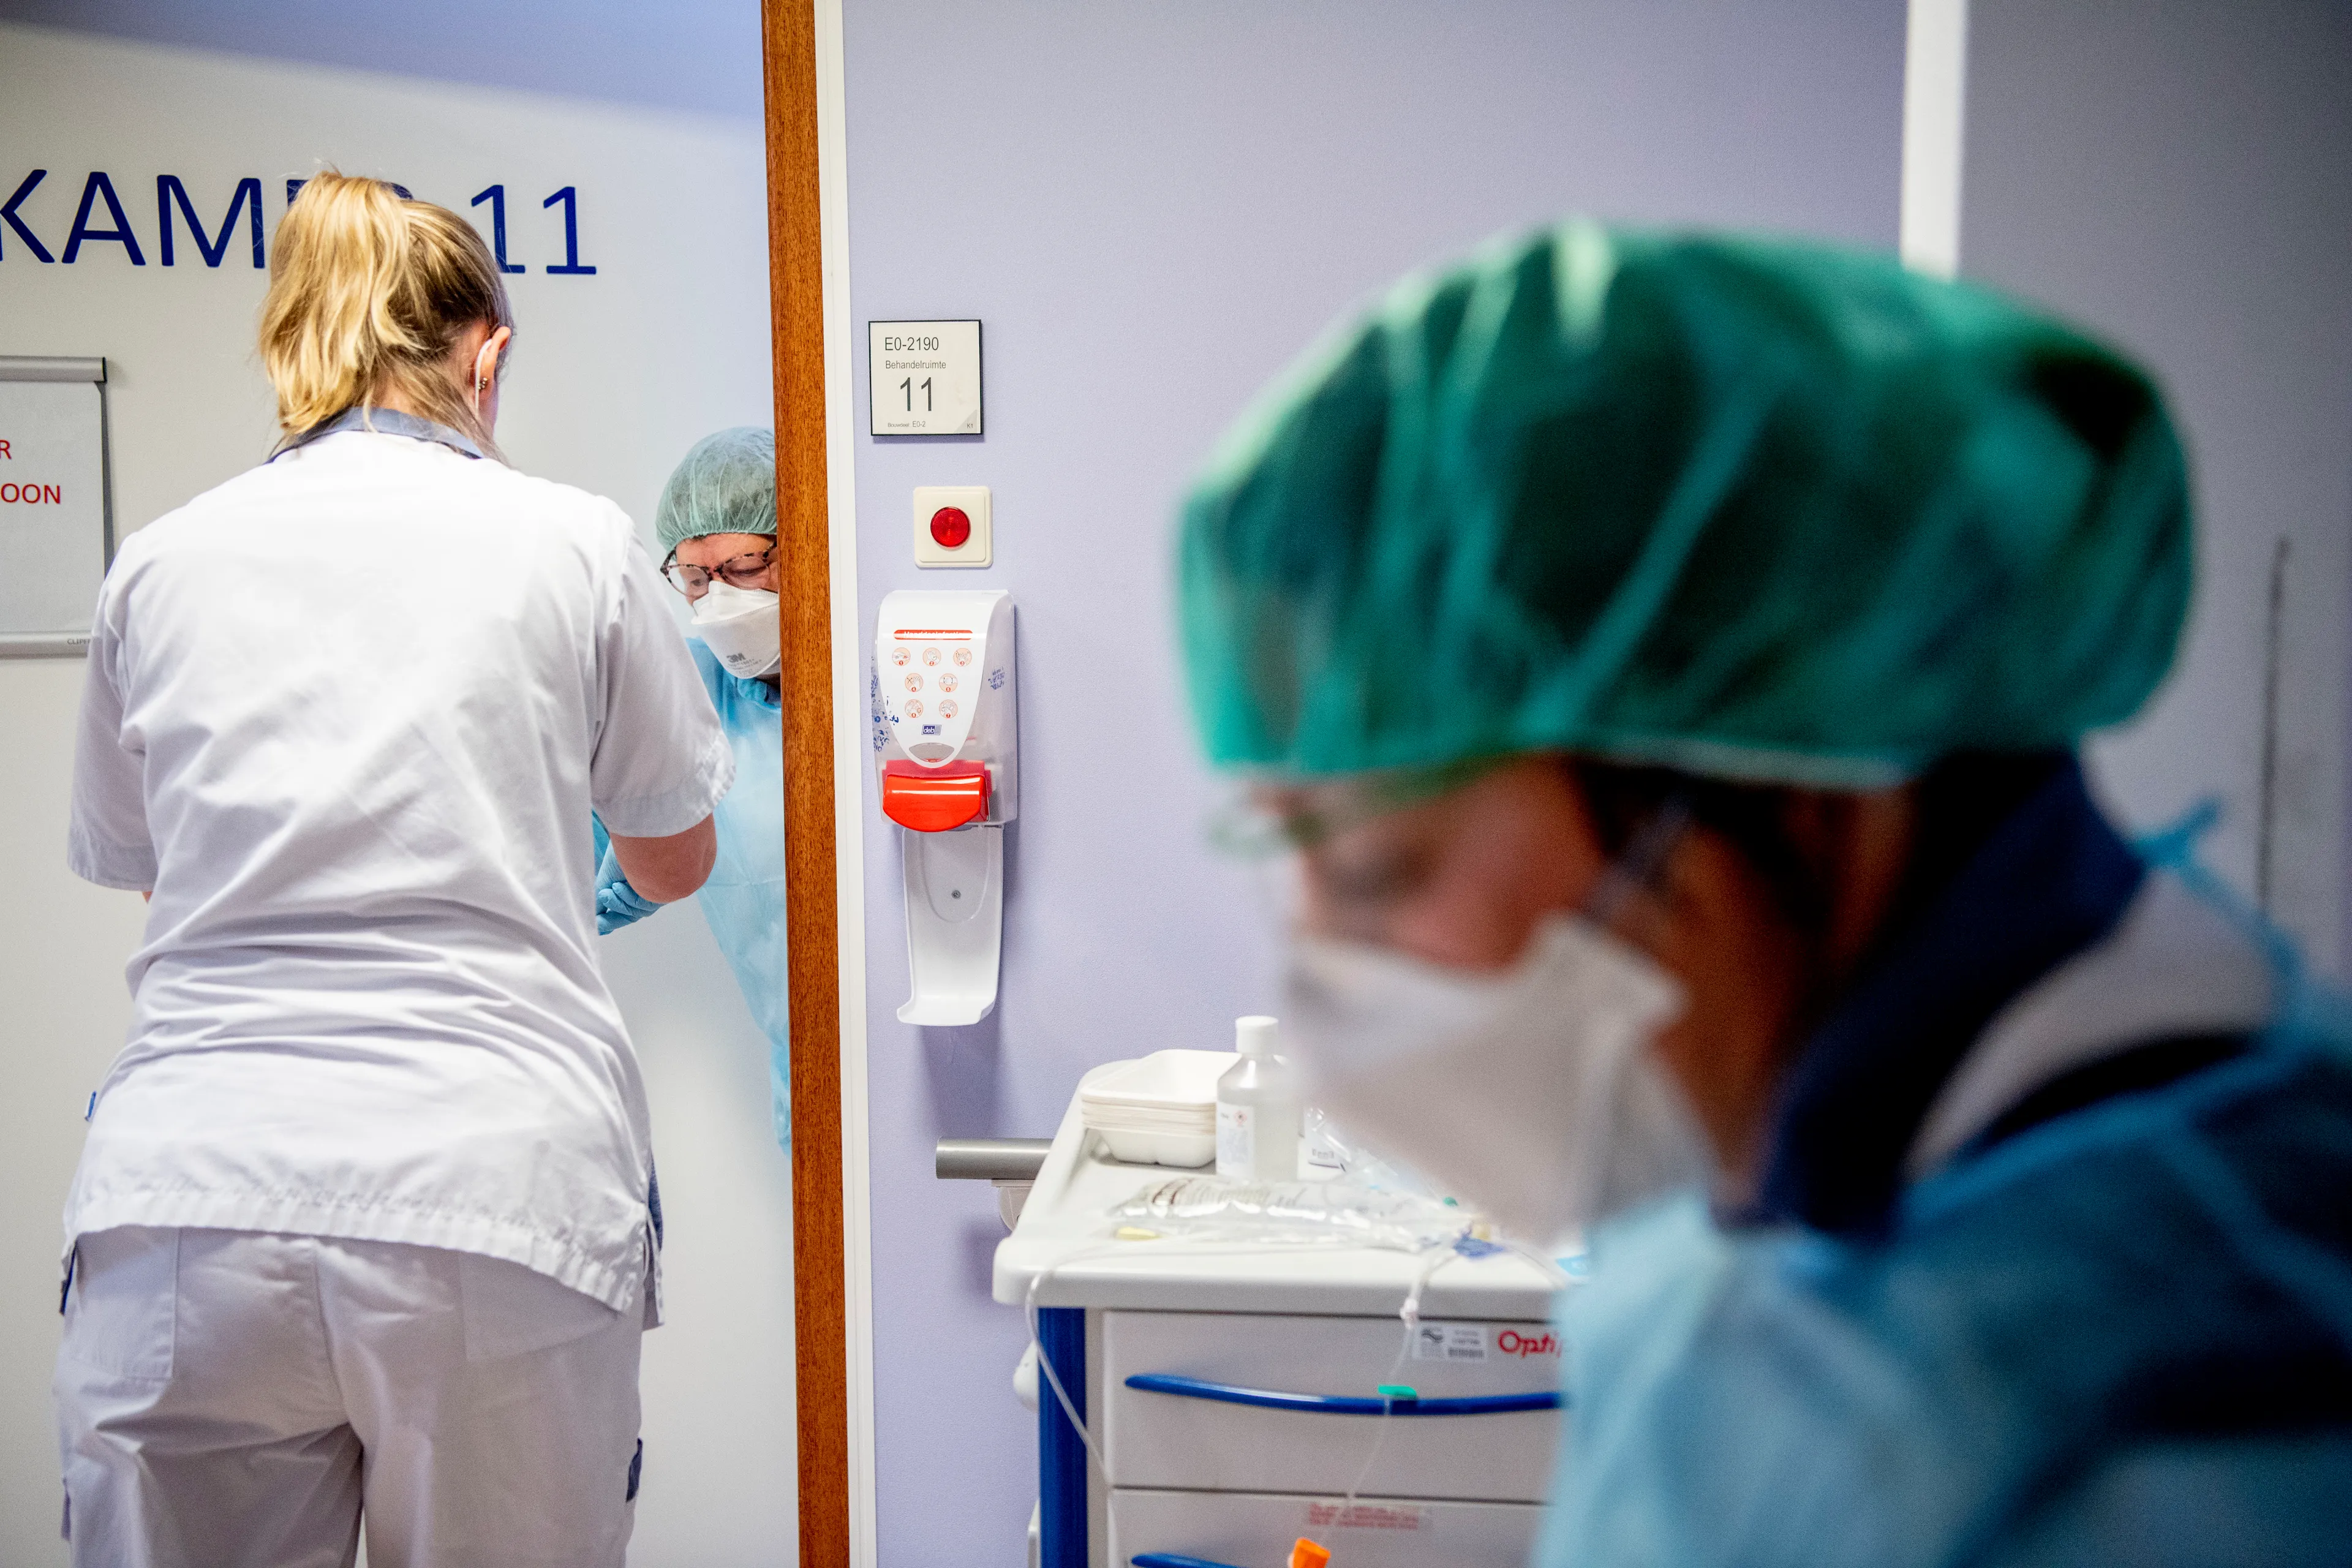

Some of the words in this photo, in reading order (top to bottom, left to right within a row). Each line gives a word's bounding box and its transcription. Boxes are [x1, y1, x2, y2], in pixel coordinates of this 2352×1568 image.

[0, 169, 414, 269] KAM
[471, 184, 597, 275] 11
[884, 336, 940, 351] E0-2190
[885, 360, 947, 369] Behandelruimte
[900, 377, 932, 412] 11
[0, 483, 61, 504] OON
[727, 652, 746, 663] 3M
